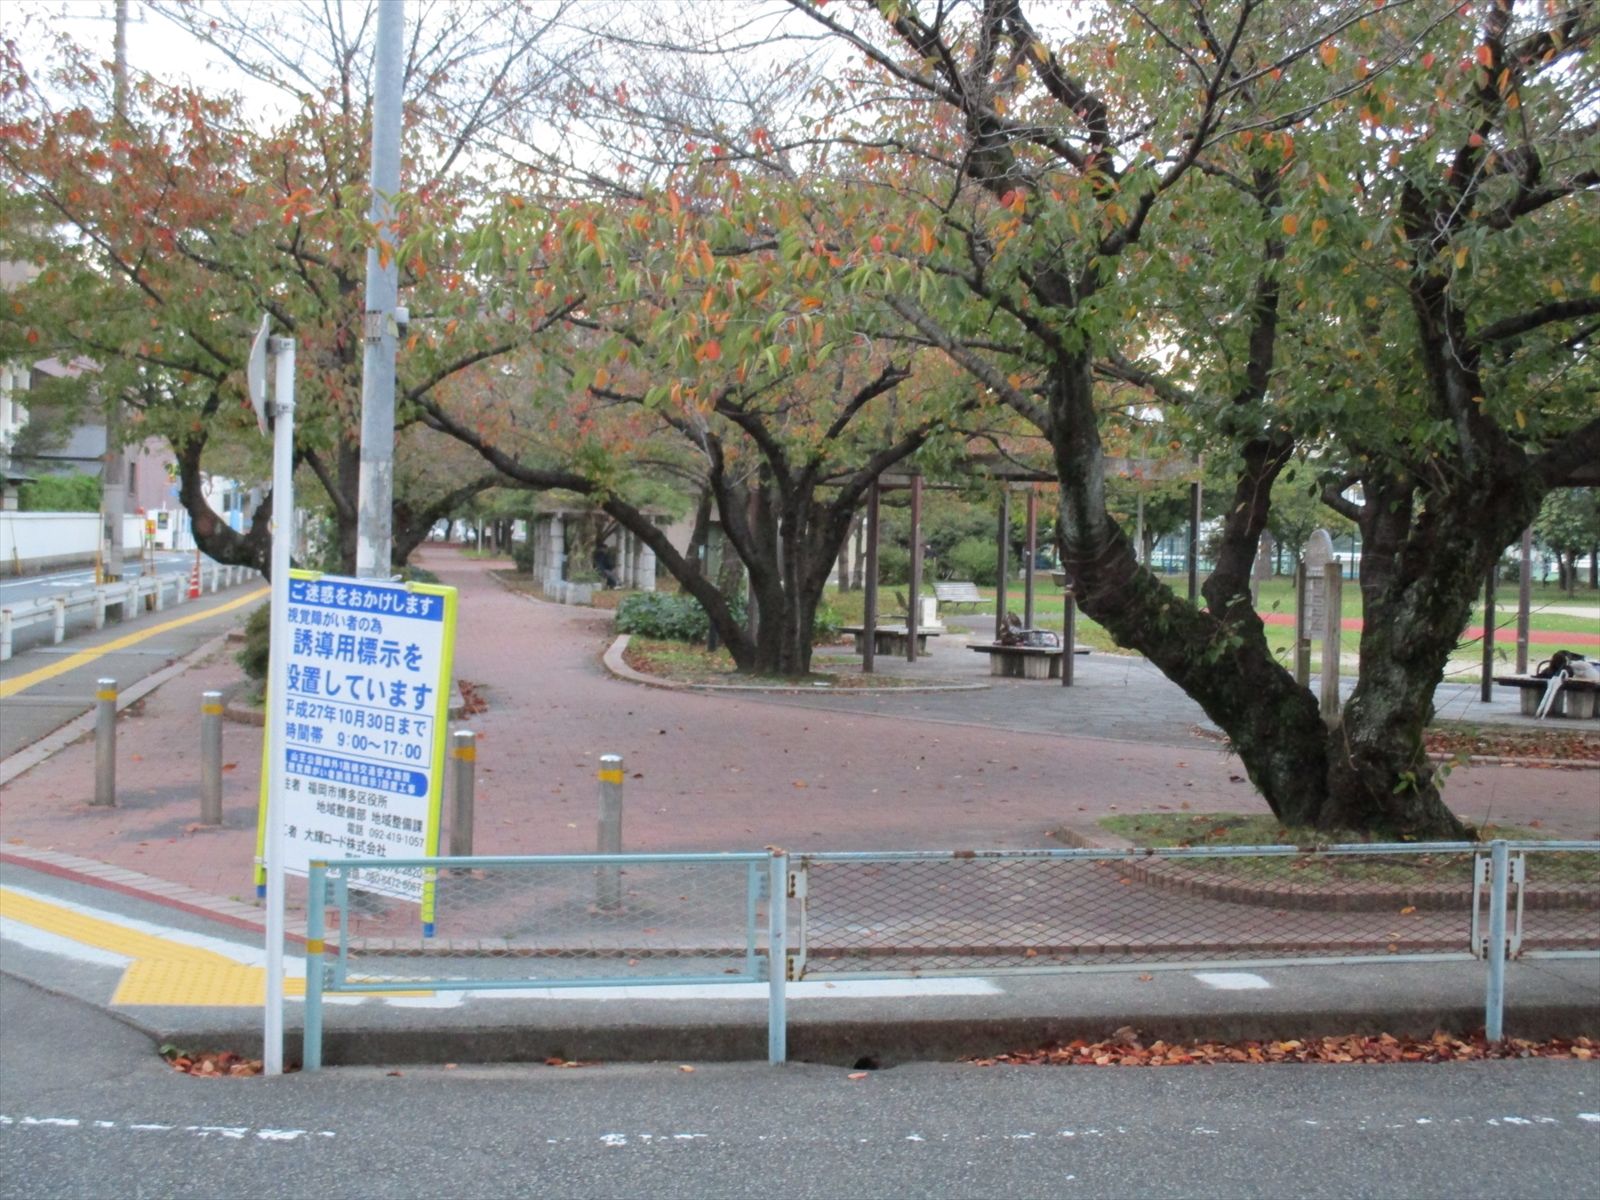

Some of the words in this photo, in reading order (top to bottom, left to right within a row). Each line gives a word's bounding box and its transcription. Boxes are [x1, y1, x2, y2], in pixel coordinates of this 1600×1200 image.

[291, 582, 435, 617] ご迷惑をおかけします
[287, 607, 383, 635] 視覚障がい者の為
[293, 628, 424, 673] 誘導用標示を
[286, 721, 324, 745] 時間帯
[308, 781, 388, 809] 福岡市博多区役所
[316, 800, 367, 822] 地域整備部
[371, 811, 423, 833] 地域整備課
[347, 822, 364, 837] 電話
